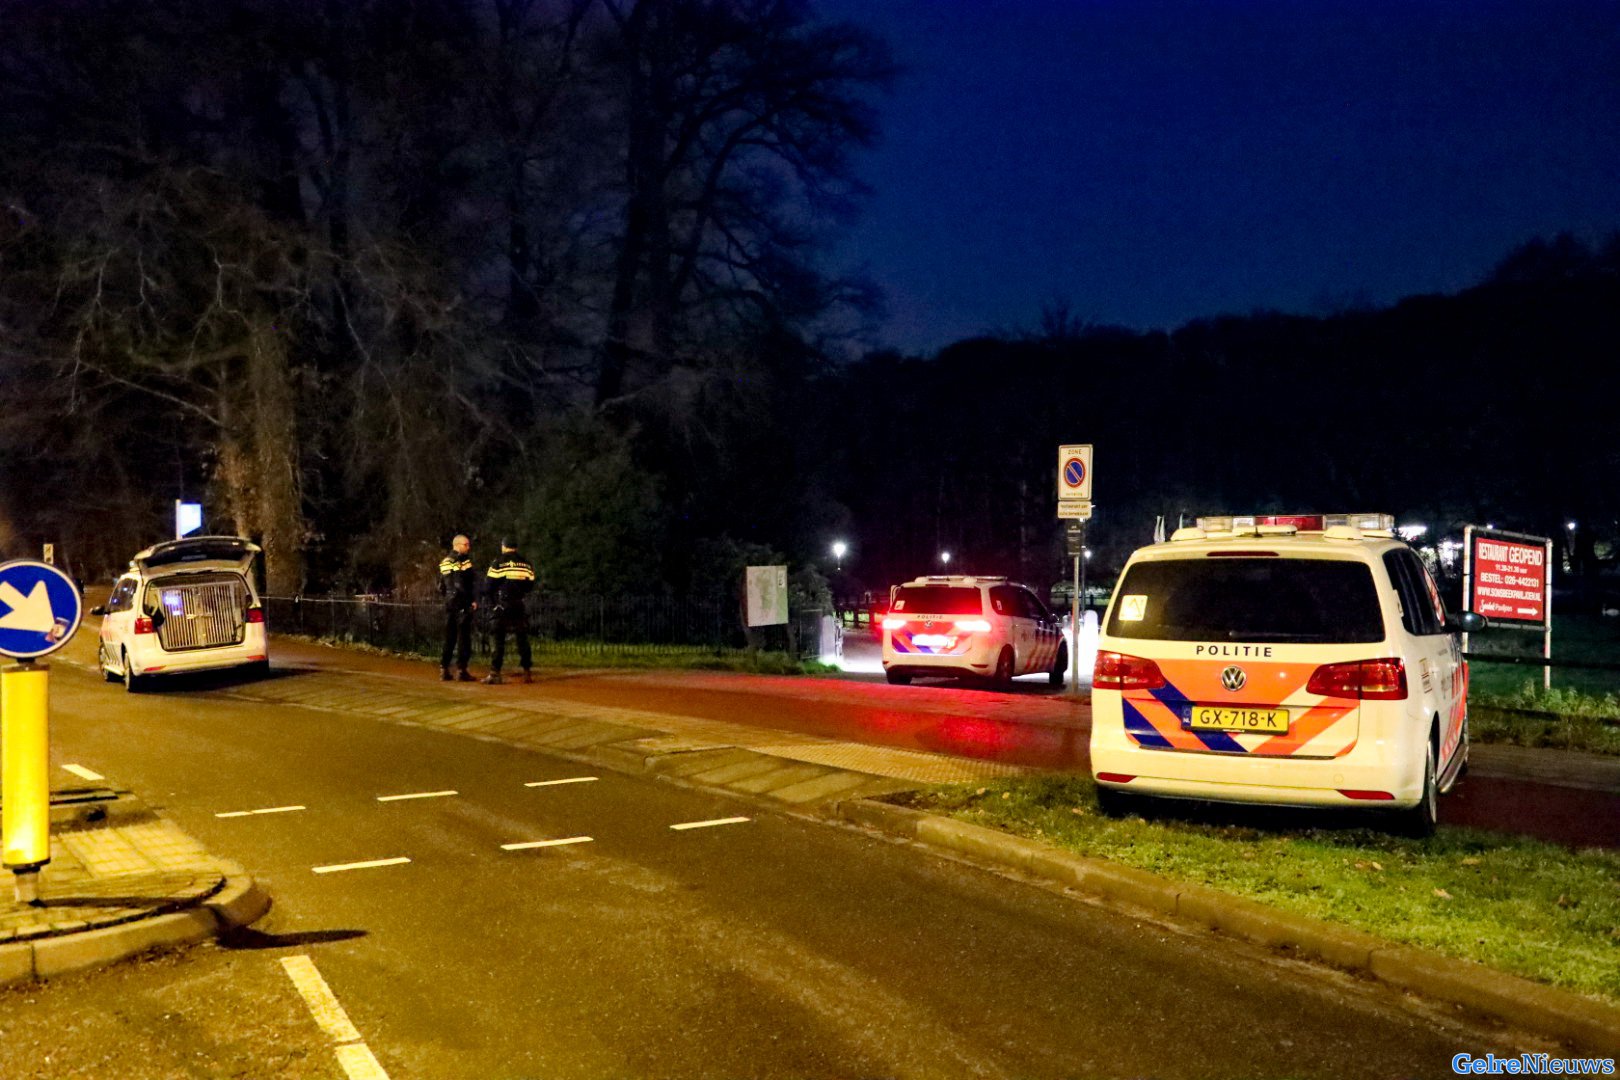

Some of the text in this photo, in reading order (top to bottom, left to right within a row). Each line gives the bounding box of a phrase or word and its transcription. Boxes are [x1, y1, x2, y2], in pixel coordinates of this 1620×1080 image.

[1509, 546, 1542, 566] GEOPEND
[1196, 645, 1273, 658] POLITIE
[1200, 709, 1277, 728] GX-718-K
